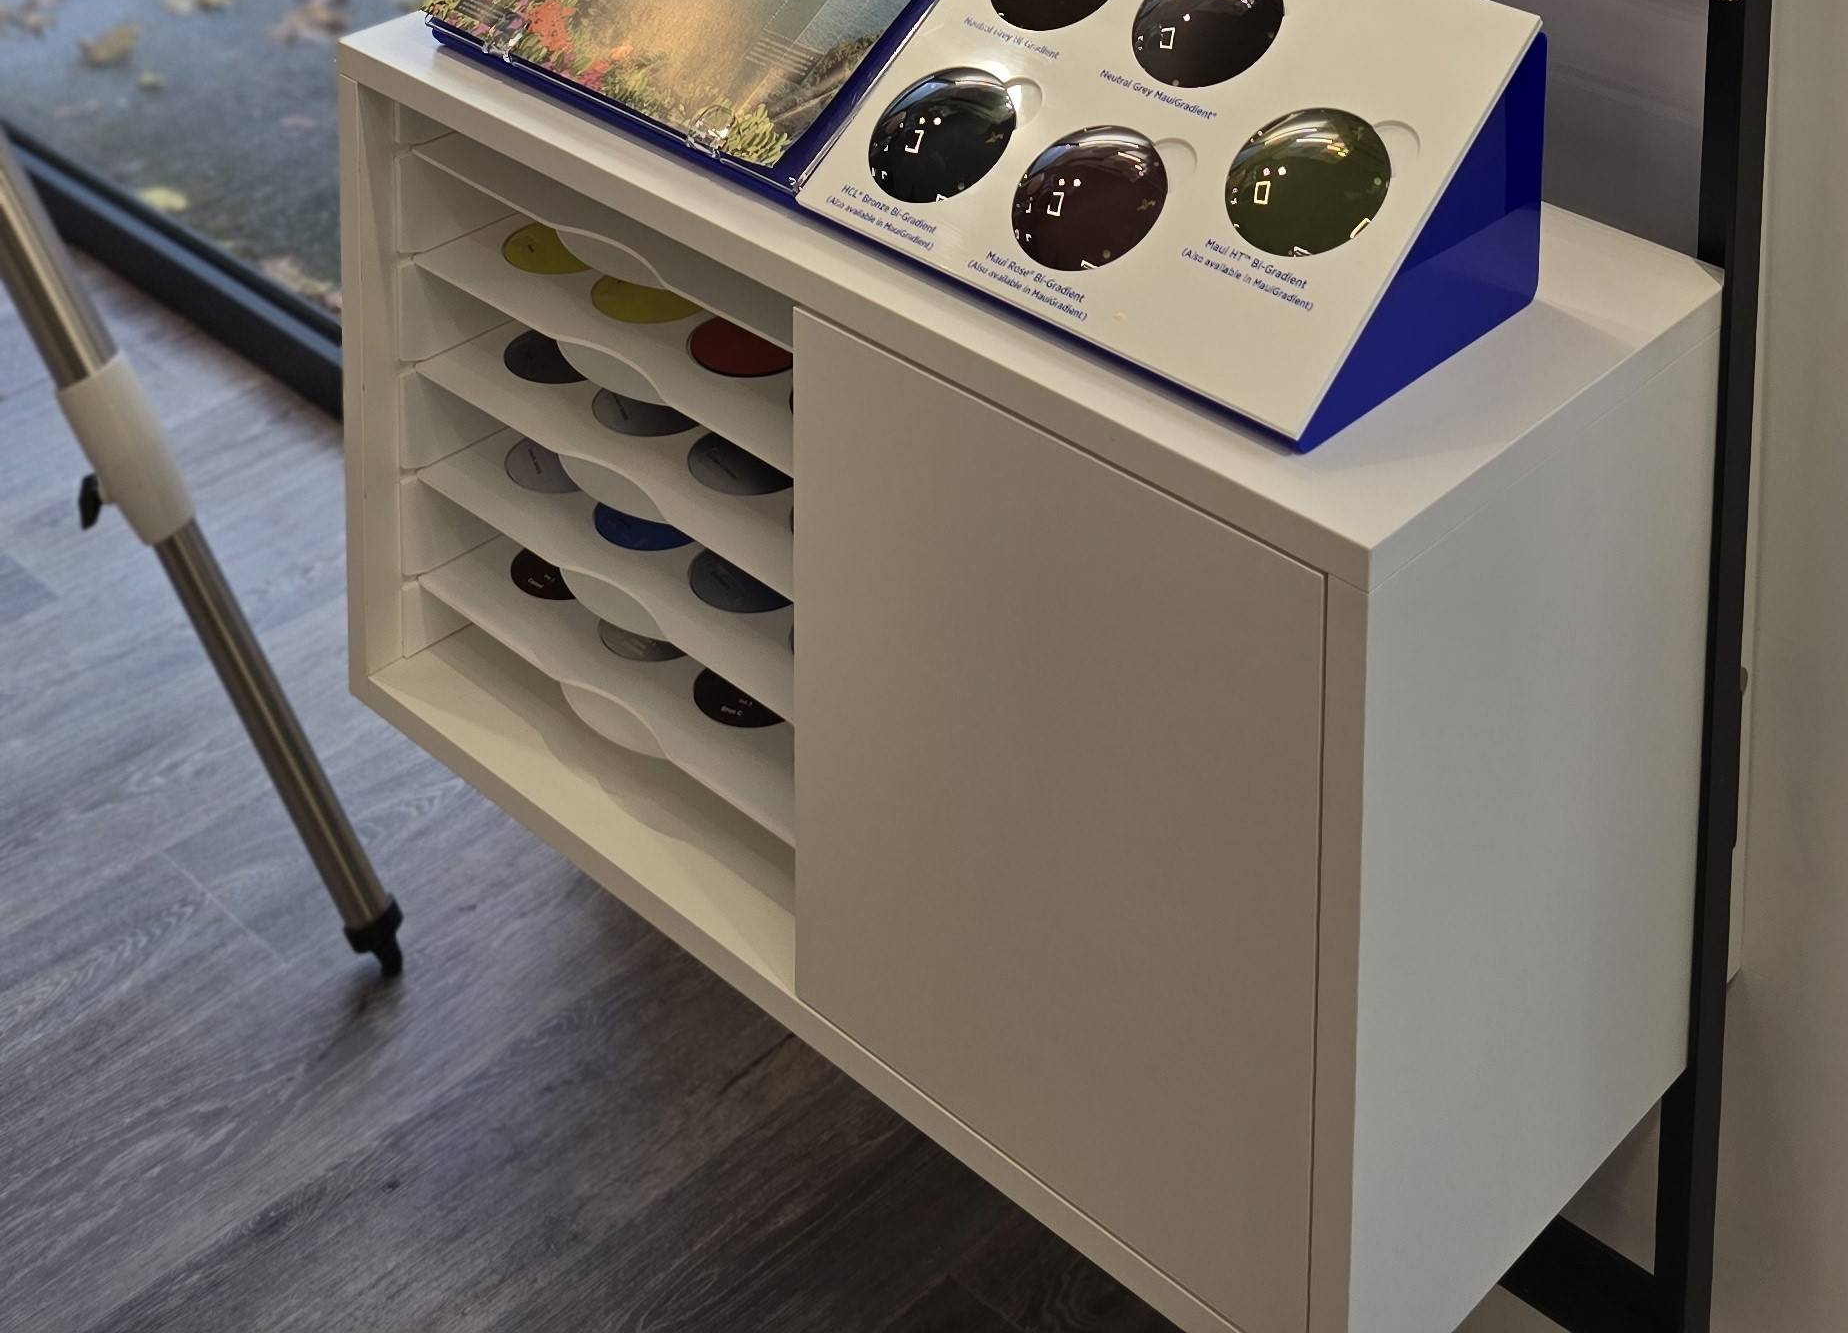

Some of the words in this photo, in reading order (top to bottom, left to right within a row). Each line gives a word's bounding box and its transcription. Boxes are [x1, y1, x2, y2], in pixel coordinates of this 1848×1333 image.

[1099, 68, 1132, 89] Neutral
[1133, 81, 1153, 97] Grey
[825, 195, 844, 210] (Also
[845, 203, 877, 224] available
[876, 218, 884, 228] in
[884, 222, 934, 251] MauiGradient)
[863, 192, 891, 213] Bronze
[891, 206, 938, 234] Bi-Gradient
[986, 250, 1008, 267] Maui
[1034, 272, 1086, 303] Bi-Gradient
[1181, 247, 1204, 263] (Also
[1204, 258, 1242, 280] available
[1242, 273, 1252, 284] in
[1253, 278, 1314, 312] MauiGradient)
[1205, 238, 1230, 255] Maui
[1251, 258, 1308, 289] Bi-Gradient
[967, 259, 988, 275] (Also
[988, 269, 1022, 290] available
[1022, 283, 1032, 294] in
[1032, 287, 1088, 322] MauiGradient)
